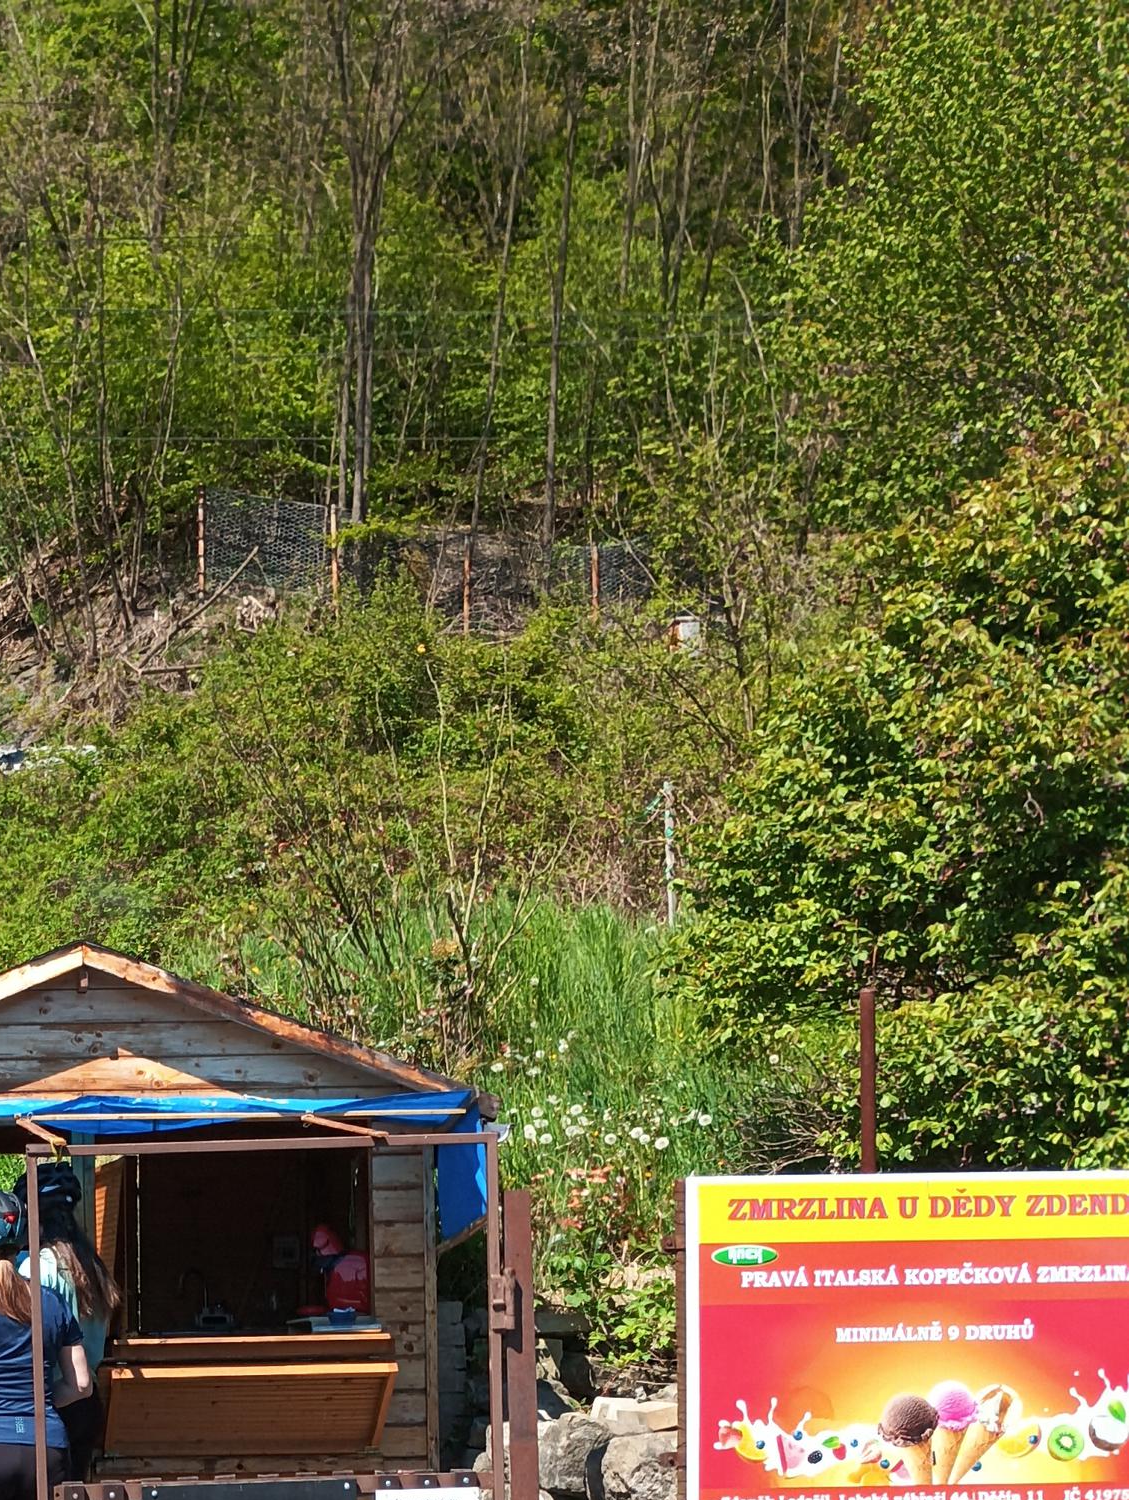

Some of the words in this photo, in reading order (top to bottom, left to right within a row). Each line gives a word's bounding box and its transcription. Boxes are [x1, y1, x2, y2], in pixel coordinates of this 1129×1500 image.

[728, 1197, 889, 1221] ZMRZLINA
[897, 1196, 919, 1219] U
[928, 1188, 1017, 1218] DĚDY
[741, 1266, 809, 1288] PRAVÁ
[814, 1265, 899, 1286] ITALSKÁ
[904, 1262, 1032, 1286] KOPEČKOVÁ
[1036, 1265, 1129, 1283] ZMRZLIN
[835, 1321, 943, 1343] MINIMÁLNĚ
[948, 1326, 960, 1341] 9
[965, 1318, 1034, 1340] DRUHŮ
